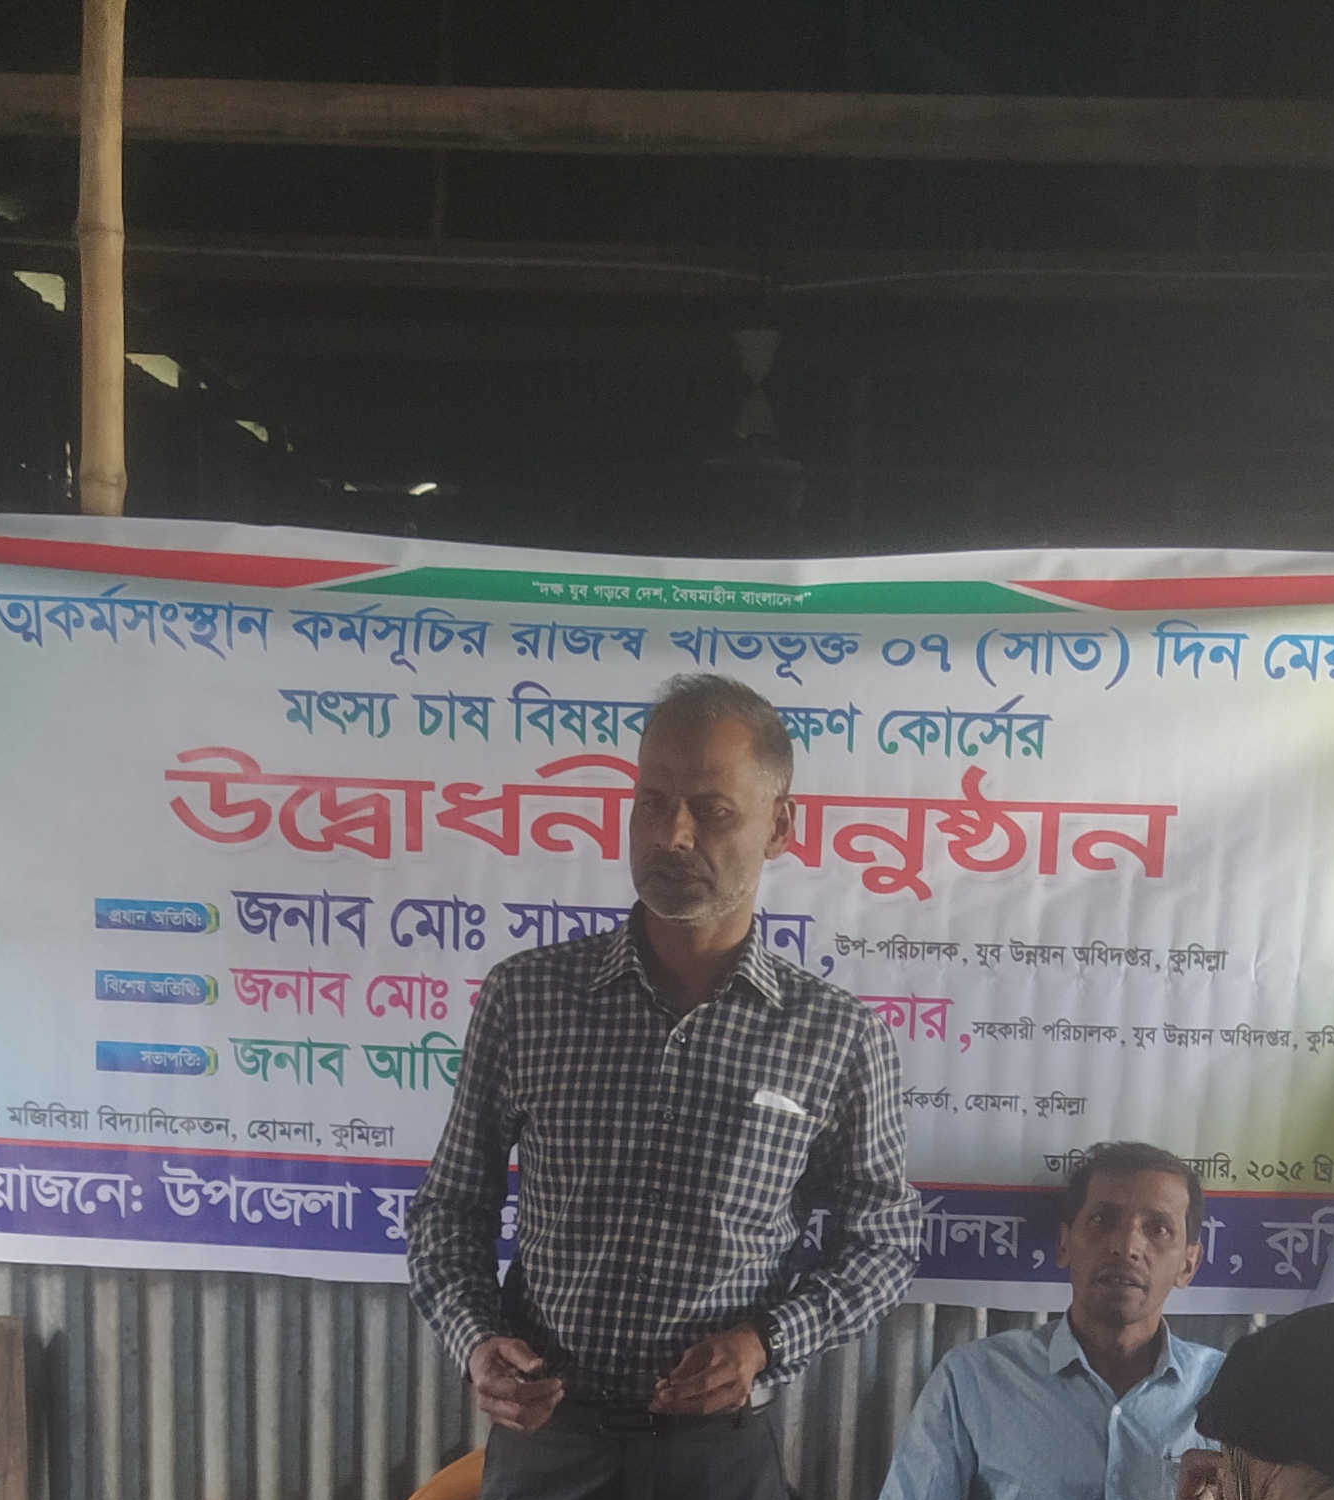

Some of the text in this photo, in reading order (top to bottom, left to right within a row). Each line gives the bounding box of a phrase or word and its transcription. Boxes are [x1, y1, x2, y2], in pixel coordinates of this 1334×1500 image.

[568, 584, 589, 601] যুব
[593, 585, 631, 602] গড়বে
[288, 602, 492, 673] কর্মসূচির
[510, 620, 648, 661] রাজস্ব
[882, 634, 952, 673] ০৭
[975, 625, 1130, 690] (সাত)
[1152, 620, 1250, 681] দিন
[278, 688, 399, 740] মৎস্য
[414, 690, 496, 742] চাষ
[877, 694, 1053, 760] কোর্সের
[229, 888, 373, 949] জনাব
[390, 894, 486, 952] মোঃ
[834, 933, 968, 967] উপ-পরিচালক,
[974, 943, 1004, 969] যুব
[1009, 937, 1067, 967] উন্নয়ন
[103, 974, 147, 994] বিশেষ
[228, 967, 351, 1018] জনাব
[365, 972, 449, 1021] মোঃ
[857, 991, 971, 1053] কার,
[971, 1016, 1036, 1041] সহকারী
[1042, 1018, 1125, 1048] পরিচালক,
[1132, 1026, 1158, 1049] যুব
[1163, 1022, 1215, 1050] উন্নয়ন
[228, 1037, 350, 1088] জনাব
[157, 1160, 362, 1231] উপজেলা
[370, 1187, 417, 1239] যু
[1246, 1160, 1306, 1182] ২০২৫
